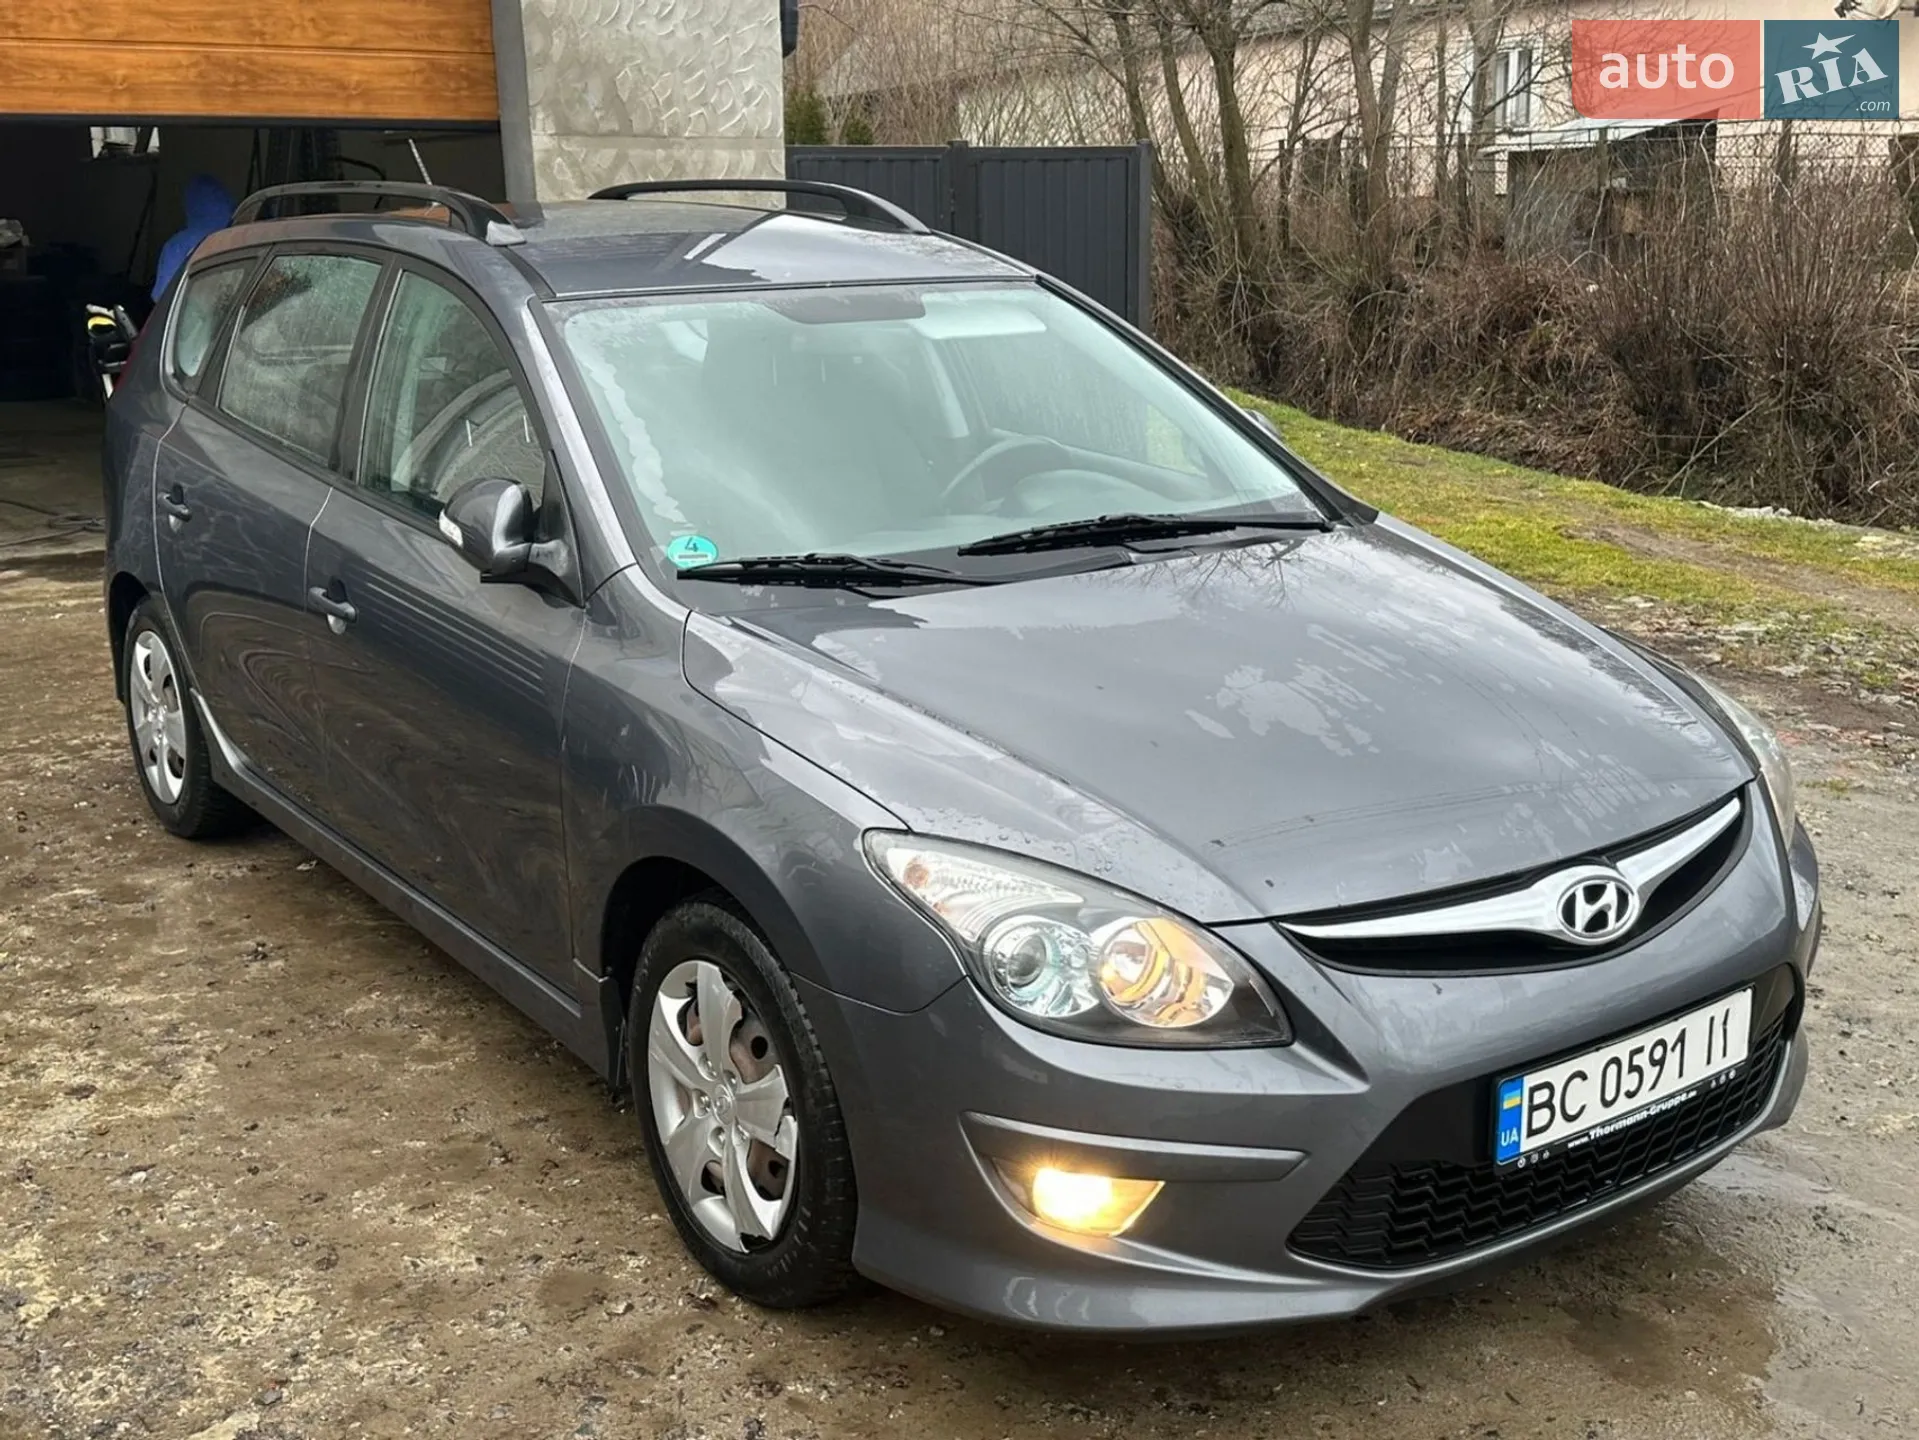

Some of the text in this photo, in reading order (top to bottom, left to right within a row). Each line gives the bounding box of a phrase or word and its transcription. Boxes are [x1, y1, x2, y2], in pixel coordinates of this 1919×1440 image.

[685, 537, 699, 552] 4
[1526, 1069, 1589, 1139] BC
[1600, 1027, 1687, 1109] 0591
[1501, 1127, 1519, 1147] UA
